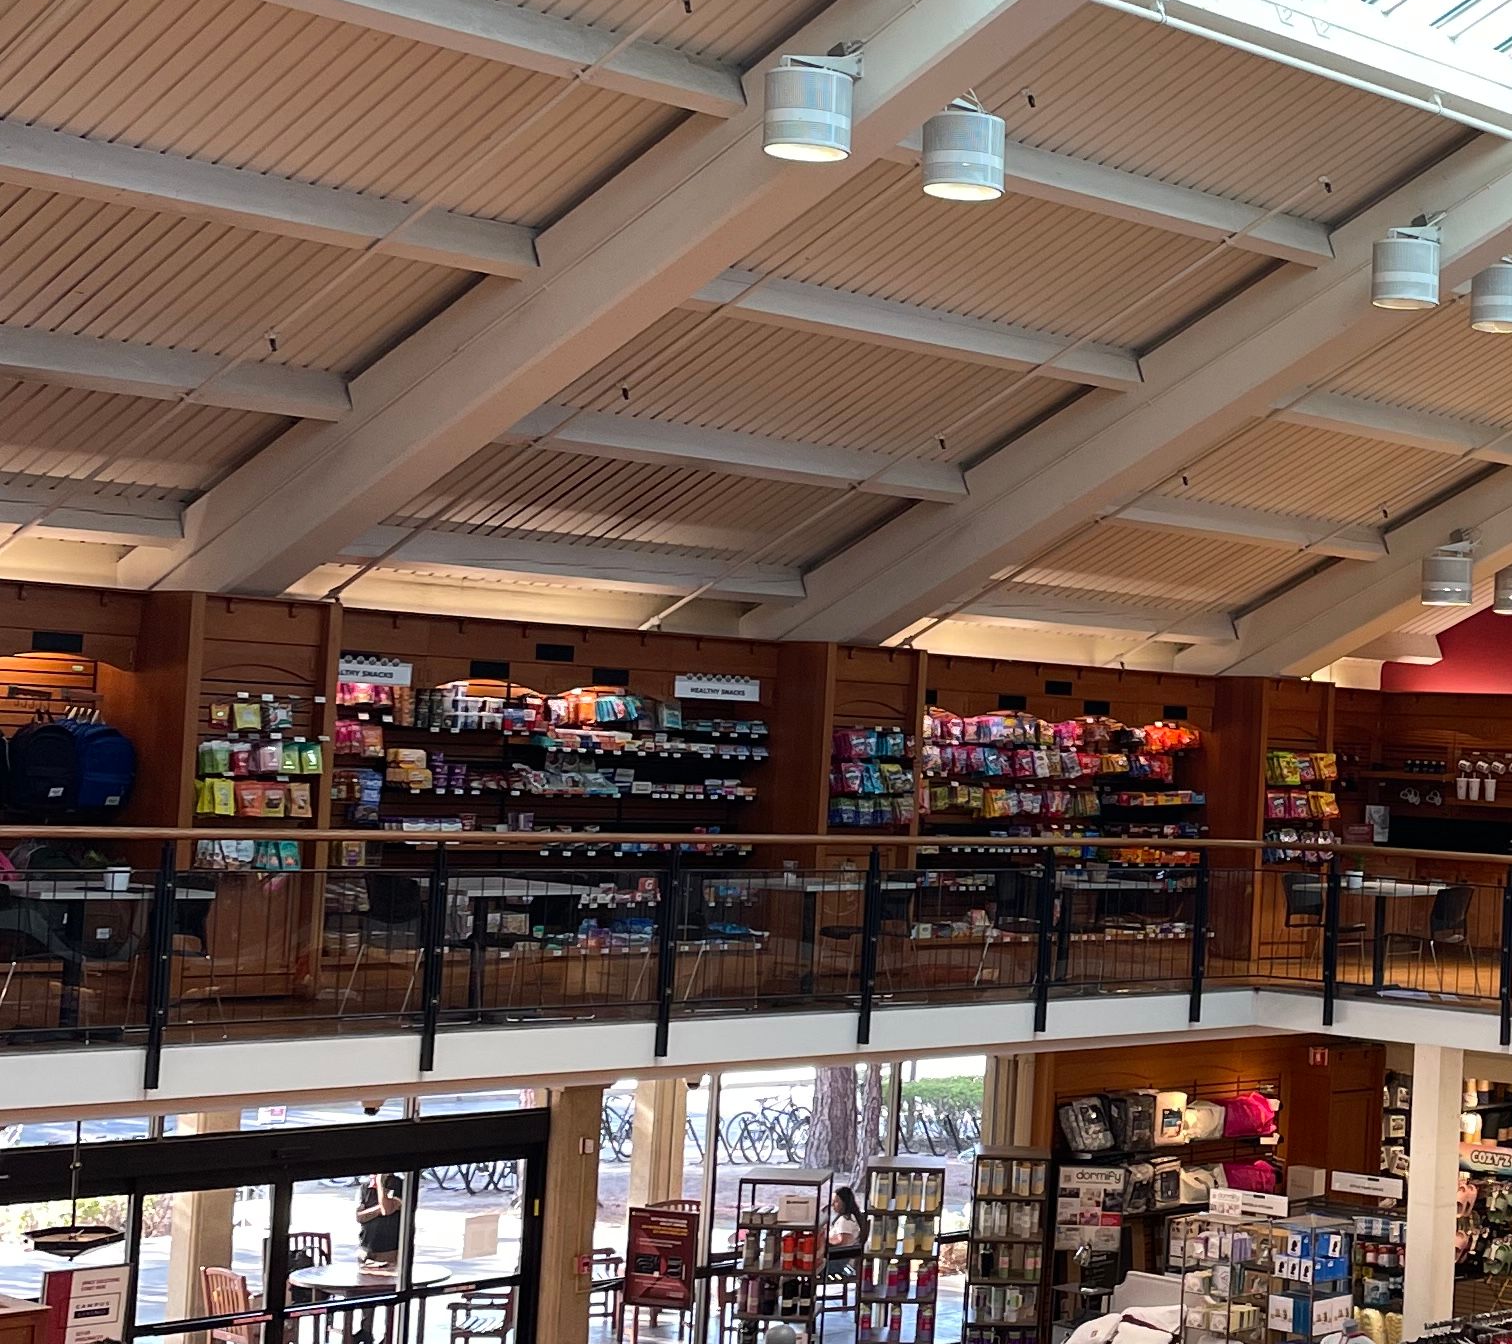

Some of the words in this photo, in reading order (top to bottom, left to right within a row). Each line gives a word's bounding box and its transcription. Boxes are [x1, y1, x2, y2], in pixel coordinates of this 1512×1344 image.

[690, 687, 720, 696] HEALTHY
[721, 689, 746, 697] SNACKS
[1076, 1169, 1121, 1184] dormify
